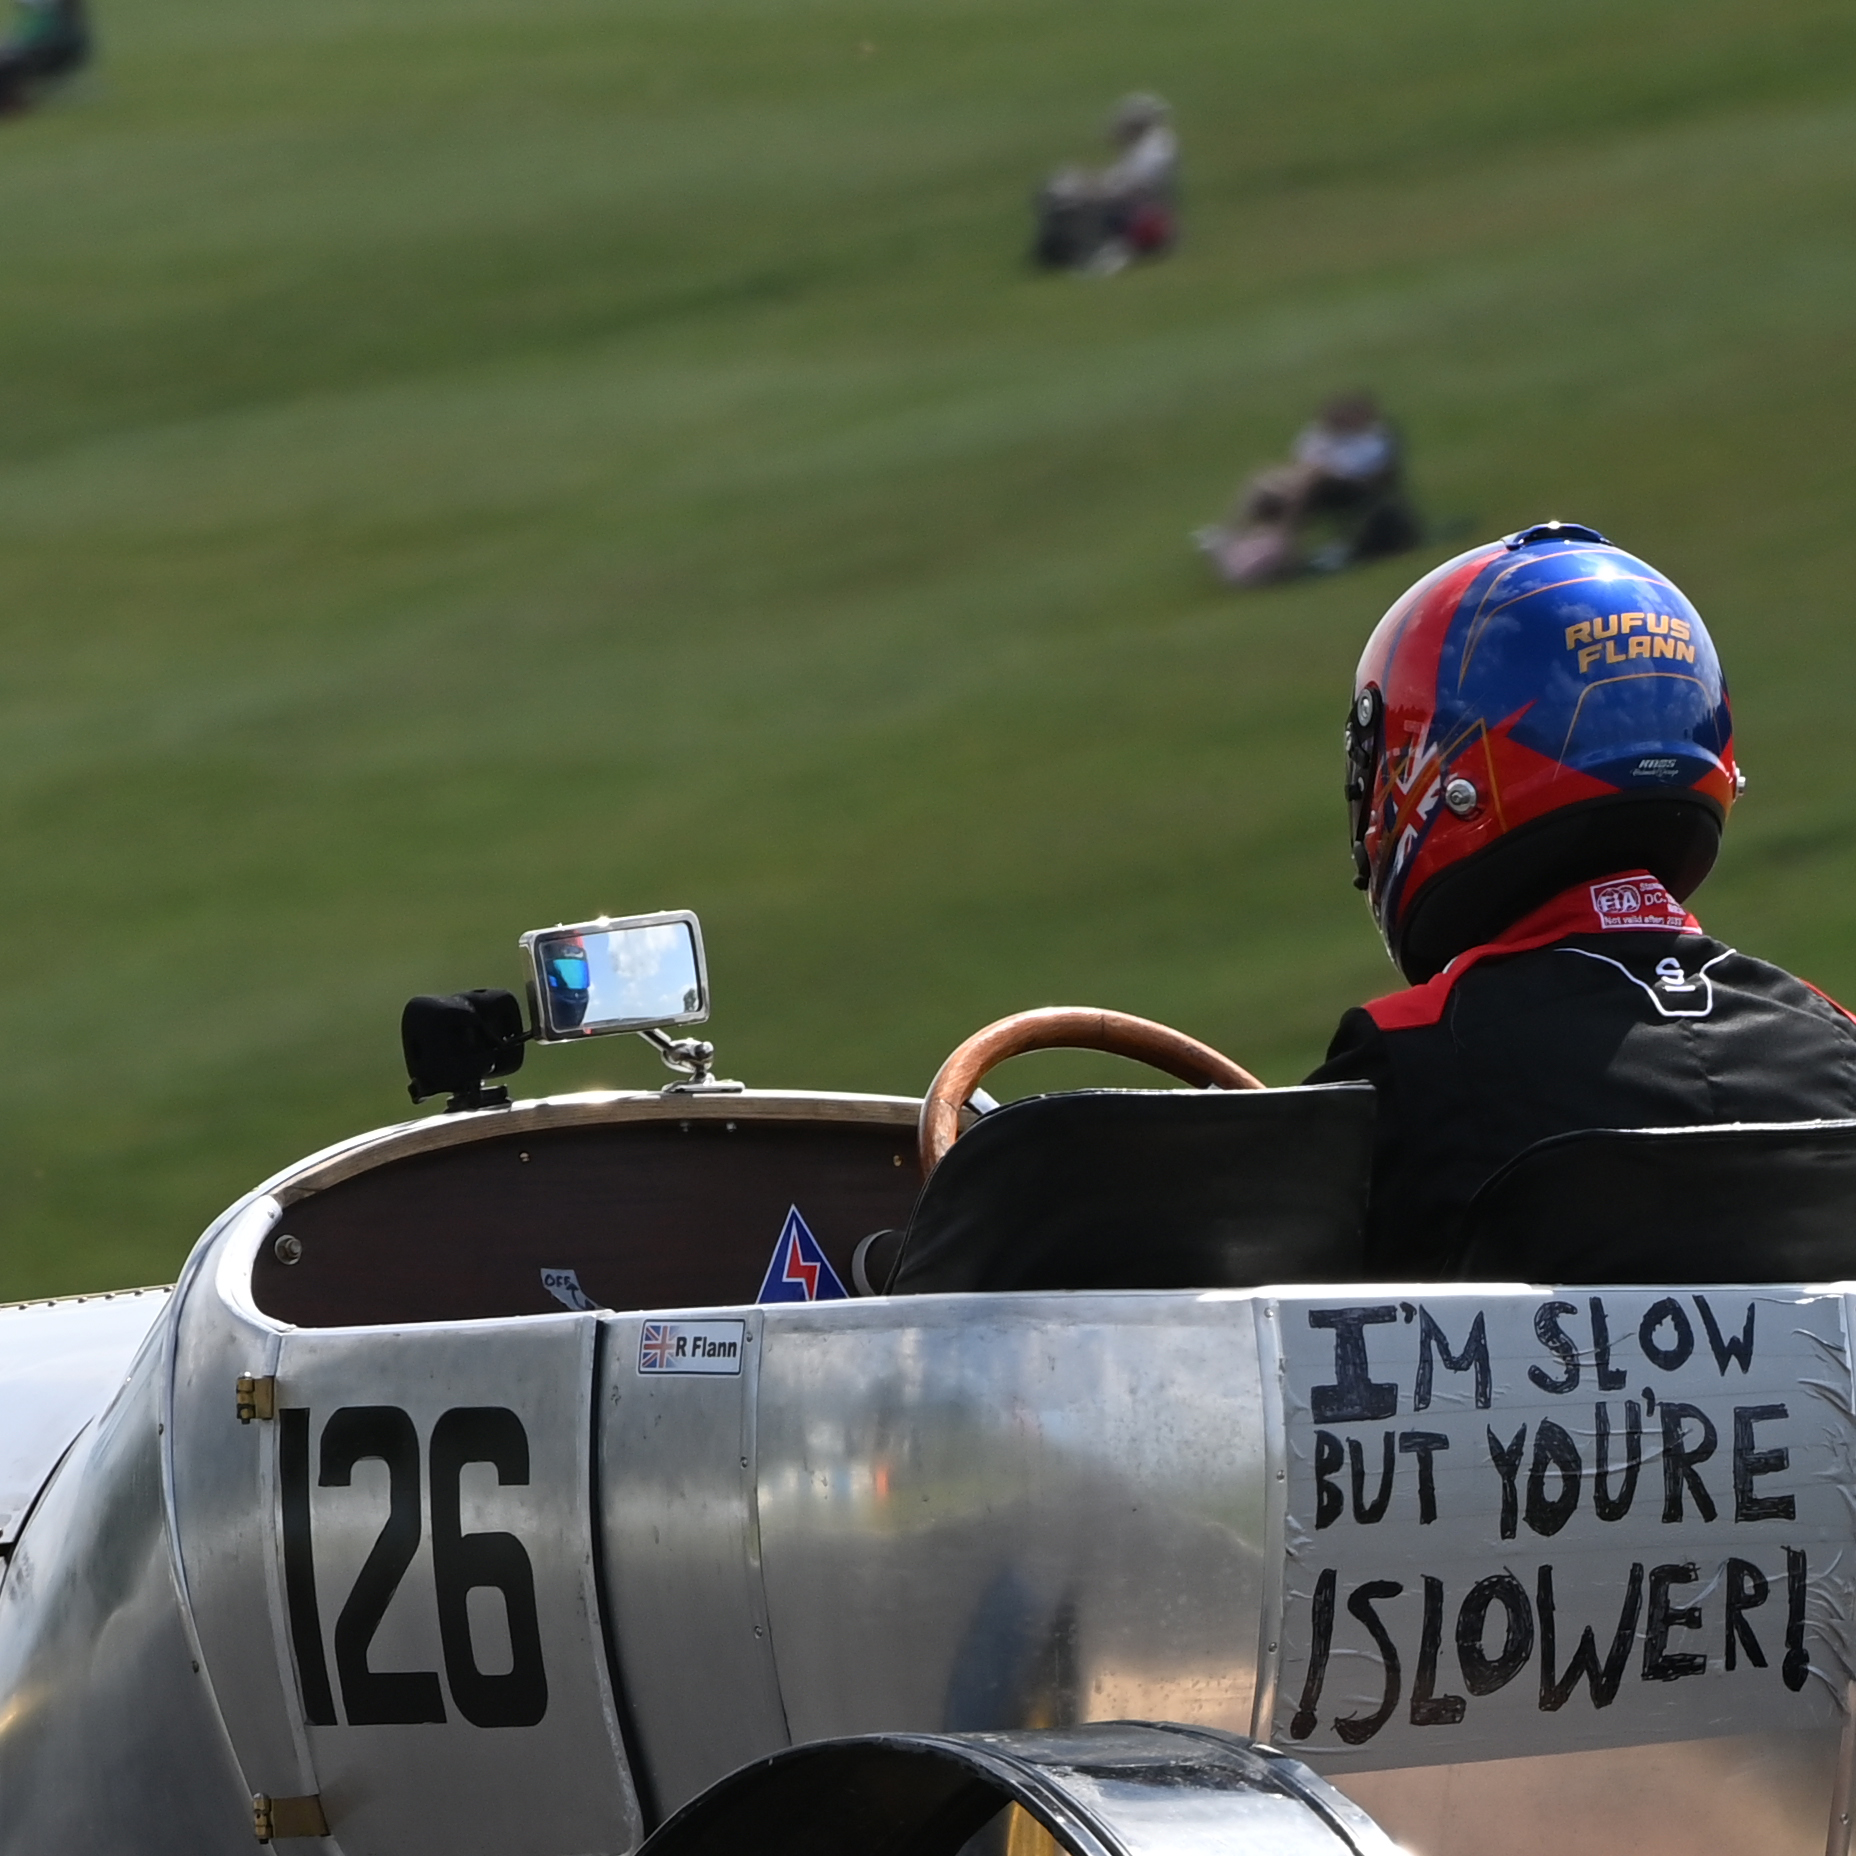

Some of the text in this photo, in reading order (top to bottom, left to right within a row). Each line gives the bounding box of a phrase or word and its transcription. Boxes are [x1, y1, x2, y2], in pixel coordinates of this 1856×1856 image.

[1565, 612, 1691, 651] RUFUS
[1578, 636, 1695, 674] FLANN
[1599, 891, 1637, 912] FIA
[1604, 916, 1621, 925] Not
[544, 1273, 571, 1287] OFF
[675, 1336, 737, 1358] R Flann
[1309, 1295, 1756, 1424] I'M SLOW
[1314, 1387, 1796, 1540] BUT YOU'RE
[279, 1404, 549, 1729] 126
